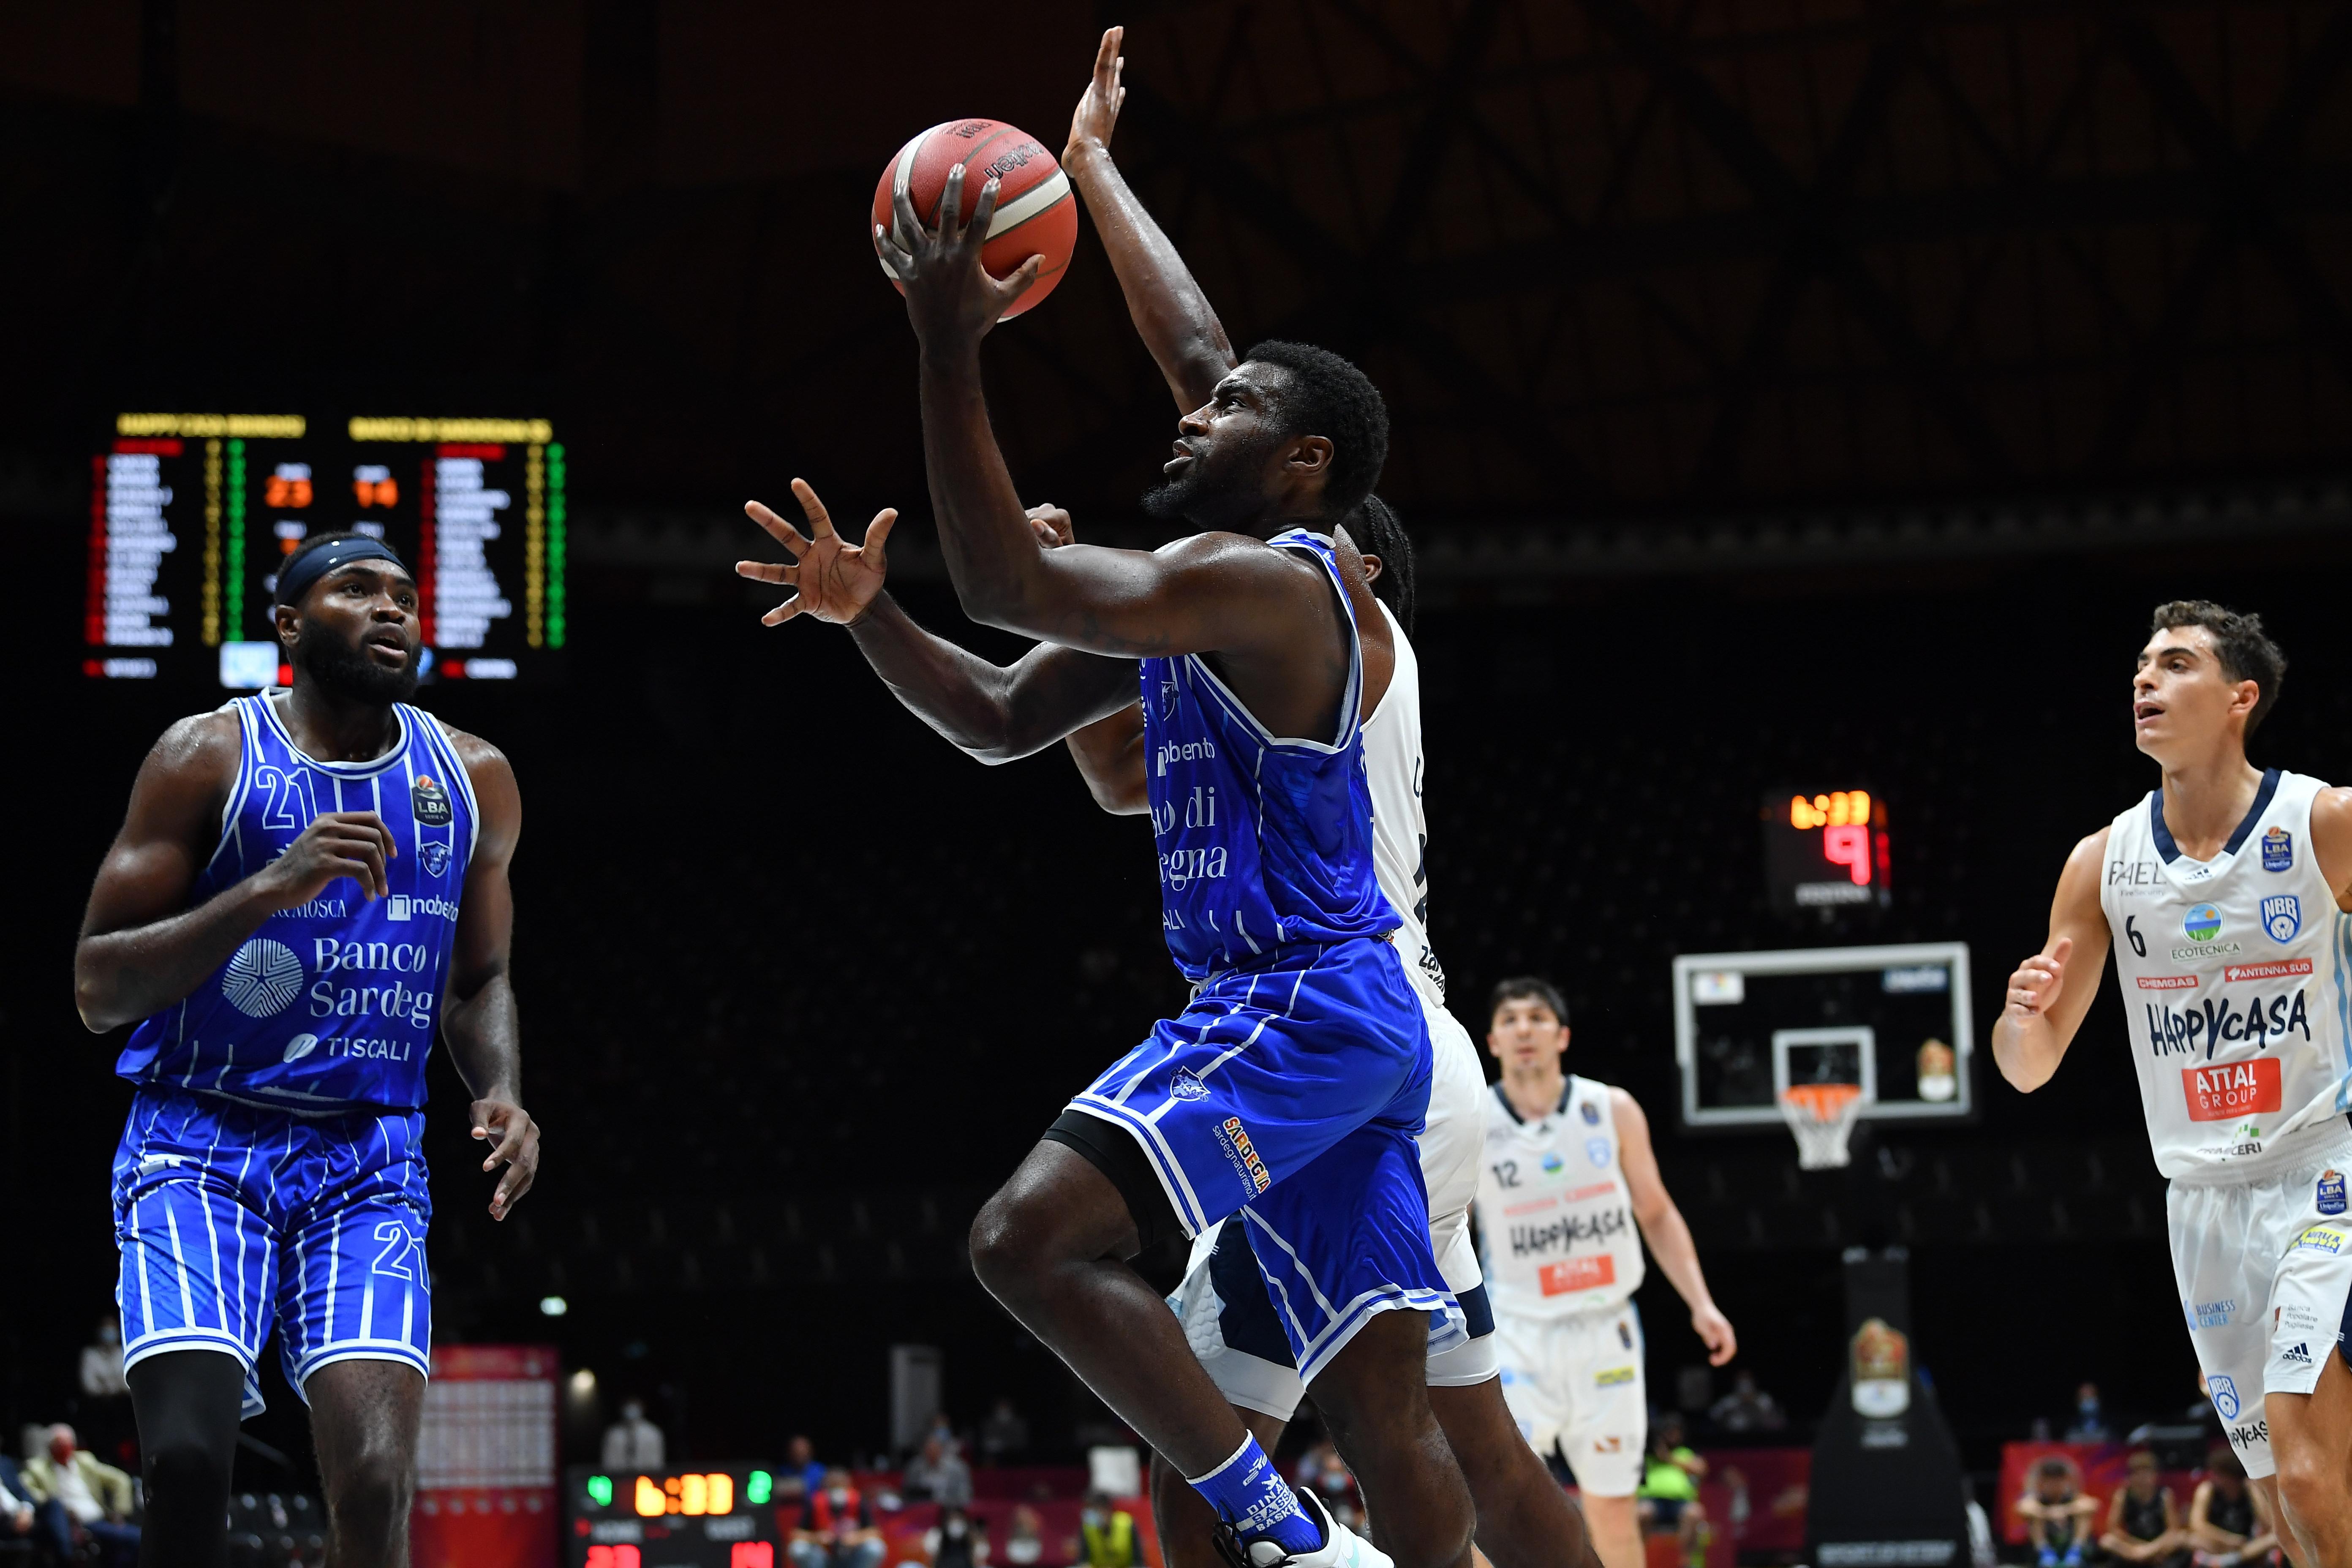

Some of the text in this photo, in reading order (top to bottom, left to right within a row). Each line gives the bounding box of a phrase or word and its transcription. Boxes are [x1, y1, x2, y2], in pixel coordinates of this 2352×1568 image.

[255, 765, 318, 830] 21
[418, 801, 449, 814] LBA
[1186, 787, 1216, 828] di
[1824, 825, 1872, 885] 9
[2265, 844, 2289, 854] LBA
[2264, 897, 2298, 924] NBB
[2126, 915, 2147, 958] 6
[313, 937, 427, 973] Banco
[2172, 943, 2240, 960] ECOTECNICA
[2240, 962, 2310, 978] ANTENNA SUD
[2139, 977, 2196, 988] CHEMGAS
[328, 1037, 411, 1062] TISCALI
[2197, 1063, 2257, 1094] ATTAL
[2200, 1087, 2257, 1109] GROUP
[1212, 1124, 1258, 1202] sardegnaturismo.it
[1492, 1159, 1522, 1190] 12
[2319, 1185, 2343, 1196] LBA
[2197, 1299, 2235, 1316] BUSINESS
[2200, 1315, 2228, 1328] CENTER
[2283, 1352, 2312, 1364] adidas
